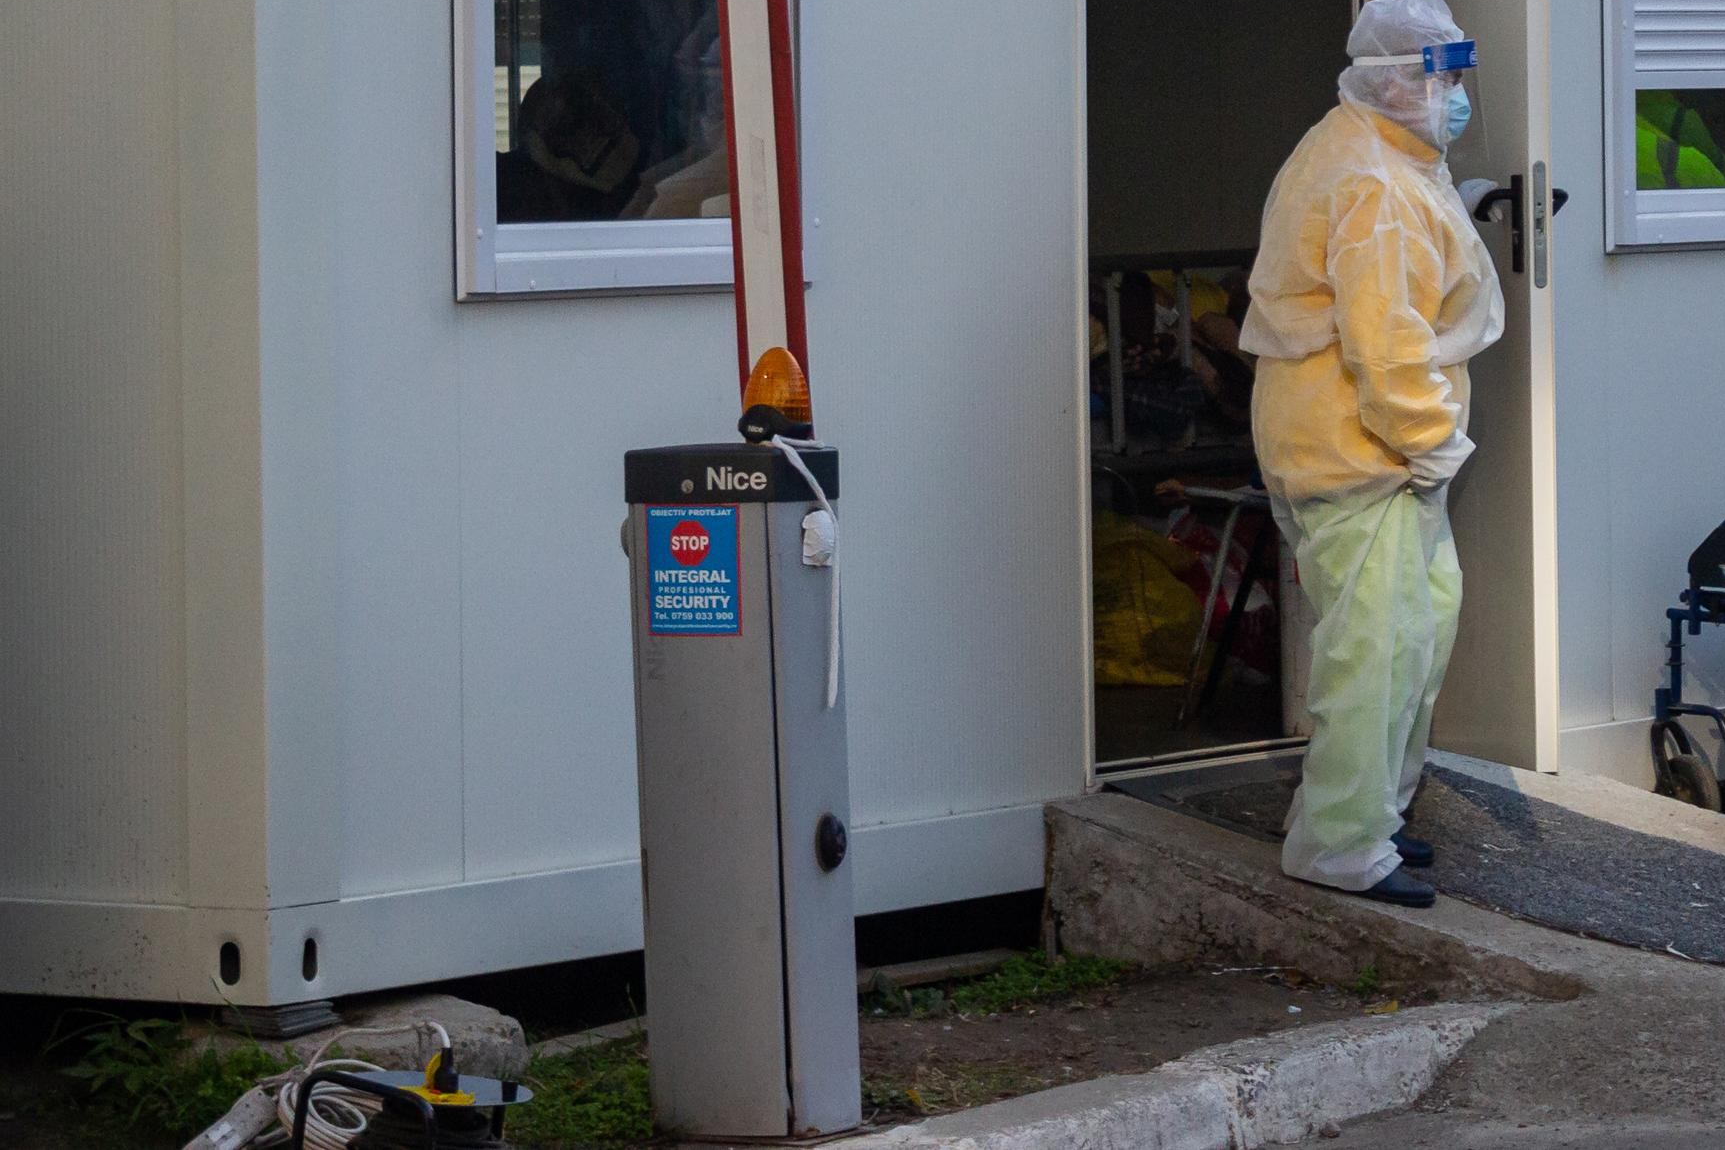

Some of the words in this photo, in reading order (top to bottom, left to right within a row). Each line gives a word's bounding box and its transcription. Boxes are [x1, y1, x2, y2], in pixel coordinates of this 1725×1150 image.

[706, 466, 768, 491] Nice
[688, 508, 732, 516] PROTEJAT
[671, 535, 710, 551] STOP
[655, 569, 731, 584] INTEGRAL
[658, 586, 726, 594] PROFESIONAL
[655, 595, 731, 609] SECURITY
[654, 611, 670, 620] Tel.
